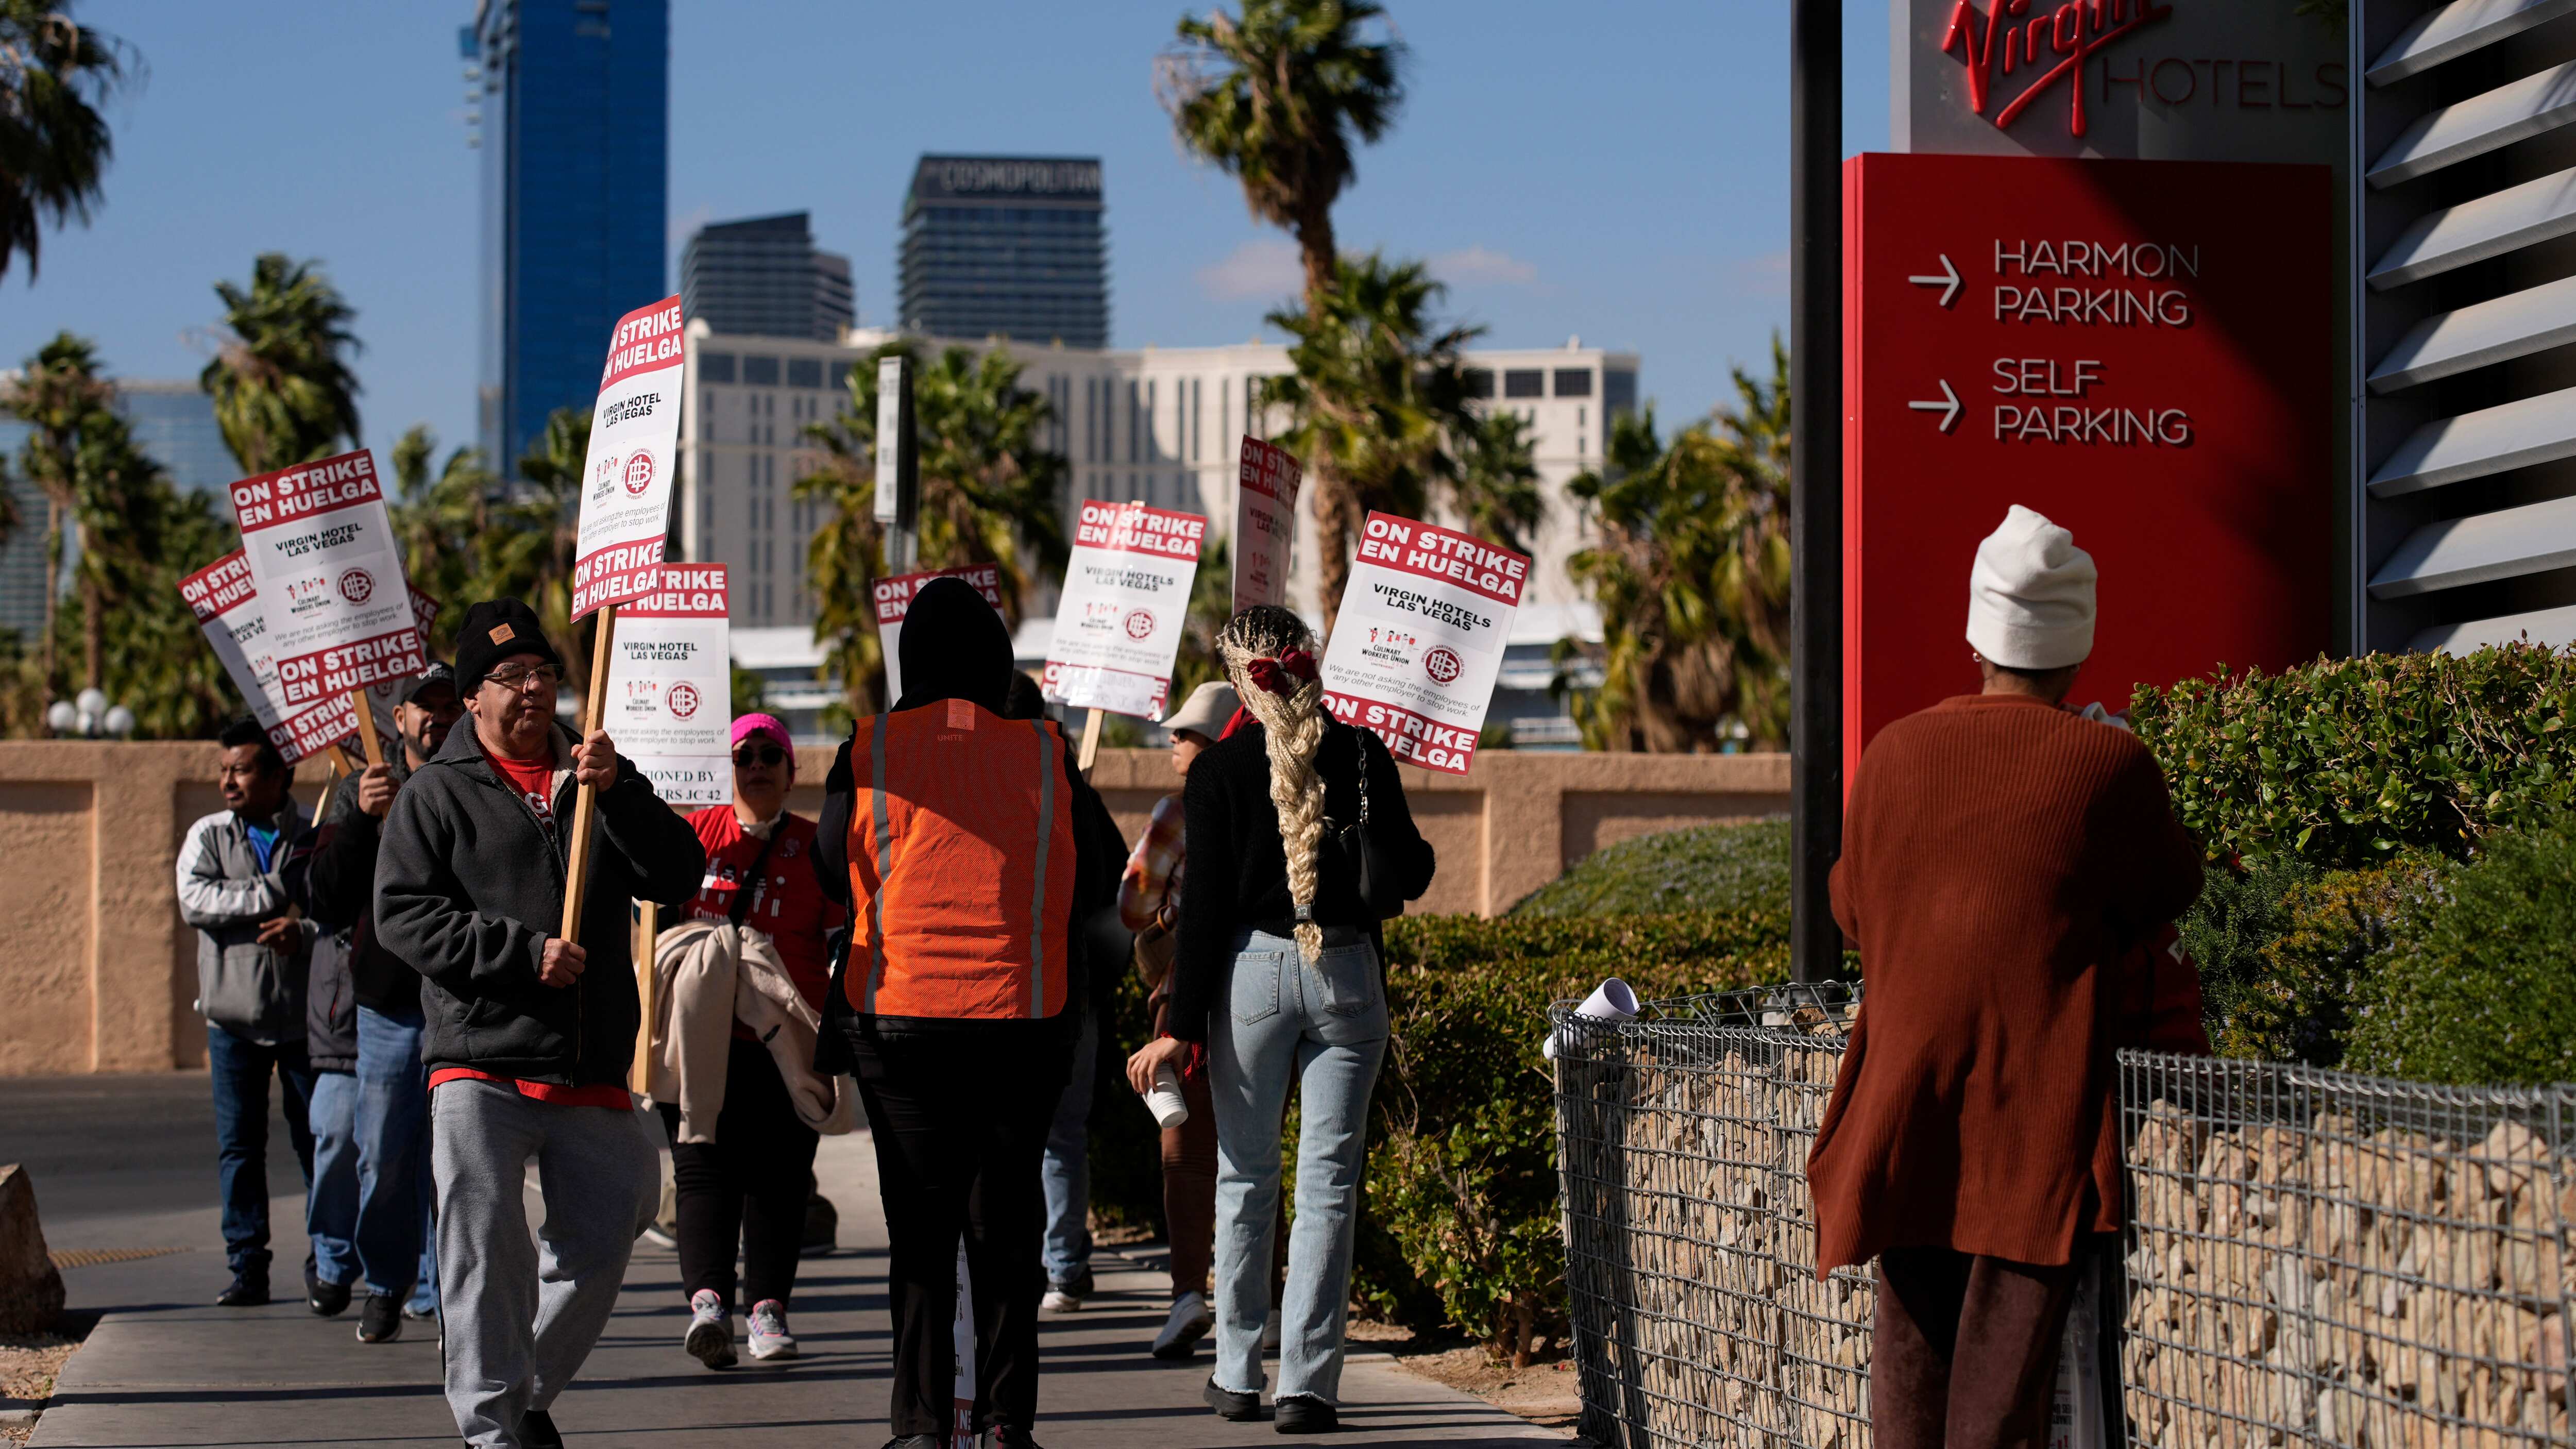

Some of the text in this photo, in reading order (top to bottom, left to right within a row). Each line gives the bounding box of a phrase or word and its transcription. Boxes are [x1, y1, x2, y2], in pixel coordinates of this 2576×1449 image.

[2104, 58, 2347, 108] HOTELS
[1994, 239, 2198, 278] HARMON
[1994, 286, 2188, 325] PARKING
[607, 305, 682, 359] N STRIKE
[601, 334, 682, 385] EN HUELGA
[1992, 358, 2100, 394] SELF
[603, 392, 662, 419] VIRGIN HOTEL
[606, 405, 652, 428] LAS VEGAS
[1994, 405, 2188, 444] PARKING
[1243, 443, 1263, 465] ON
[233, 456, 372, 507] ON STRIKE
[598, 480, 611, 491] CULINARY
[1241, 464, 1260, 485] EN
[239, 478, 377, 527] EN HUELGA
[593, 486, 615, 501] WORKERS UNION
[599, 513, 615, 525] asking
[625, 504, 659, 517] employees
[660, 500, 667, 509] of
[1082, 506, 1204, 539] ON STRIKE
[276, 523, 363, 550] VIRGIN HOTEL
[598, 523, 620, 536] employer
[629, 517, 643, 528] stop
[287, 534, 355, 558] LAS VEGAS
[1078, 525, 1197, 557] EN HUELGA
[1367, 519, 1526, 580] ON STRIKE
[575, 540, 664, 588] ON STRIKE
[1361, 539, 1517, 599] EN HUELGA
[182, 555, 250, 602] ON STRI
[572, 567, 657, 615] EN HUELGA
[660, 570, 725, 589] RIKE
[876, 581, 909, 601] ON
[1096, 576, 1159, 592] LAS VEGAS
[1127, 571, 1174, 585] HOTELS
[192, 575, 257, 618] EN HUEL
[636, 593, 725, 611] HUELGA
[878, 600, 910, 618] EN
[1374, 583, 1492, 628] VIRGIN HOTELS
[316, 620, 338, 631] asking
[354, 606, 394, 620] employees
[1387, 597, 1471, 631] LAS VEGAS
[298, 634, 315, 644] other
[317, 625, 350, 638] employer
[362, 618, 378, 627] stop
[280, 656, 318, 682] ON
[324, 631, 418, 671] STRIKE
[623, 642, 698, 651] VIRGIN HOTEL
[651, 652, 688, 660] VEGAS
[1362, 648, 1410, 665] WORKERS UNION
[1374, 644, 1401, 656] CULINARY
[286, 678, 319, 702] EN
[324, 653, 423, 692] HUELGA
[1329, 664, 1343, 673] We
[1362, 672, 1377, 680] not
[1378, 676, 1406, 688] asking
[1408, 682, 1422, 692] the
[1423, 689, 1469, 709] employees
[1333, 675, 1349, 683] any
[1351, 678, 1374, 687] other
[1375, 683, 1415, 699] employer
[1427, 699, 1445, 711] stop
[270, 723, 296, 746] ON
[674, 728, 715, 737] employees
[1320, 694, 1475, 752] ON STRIKE
[280, 742, 303, 763] EN
[301, 712, 359, 752] HUELG
[699, 771, 716, 781] BY
[686, 790, 721, 800] JC 42
